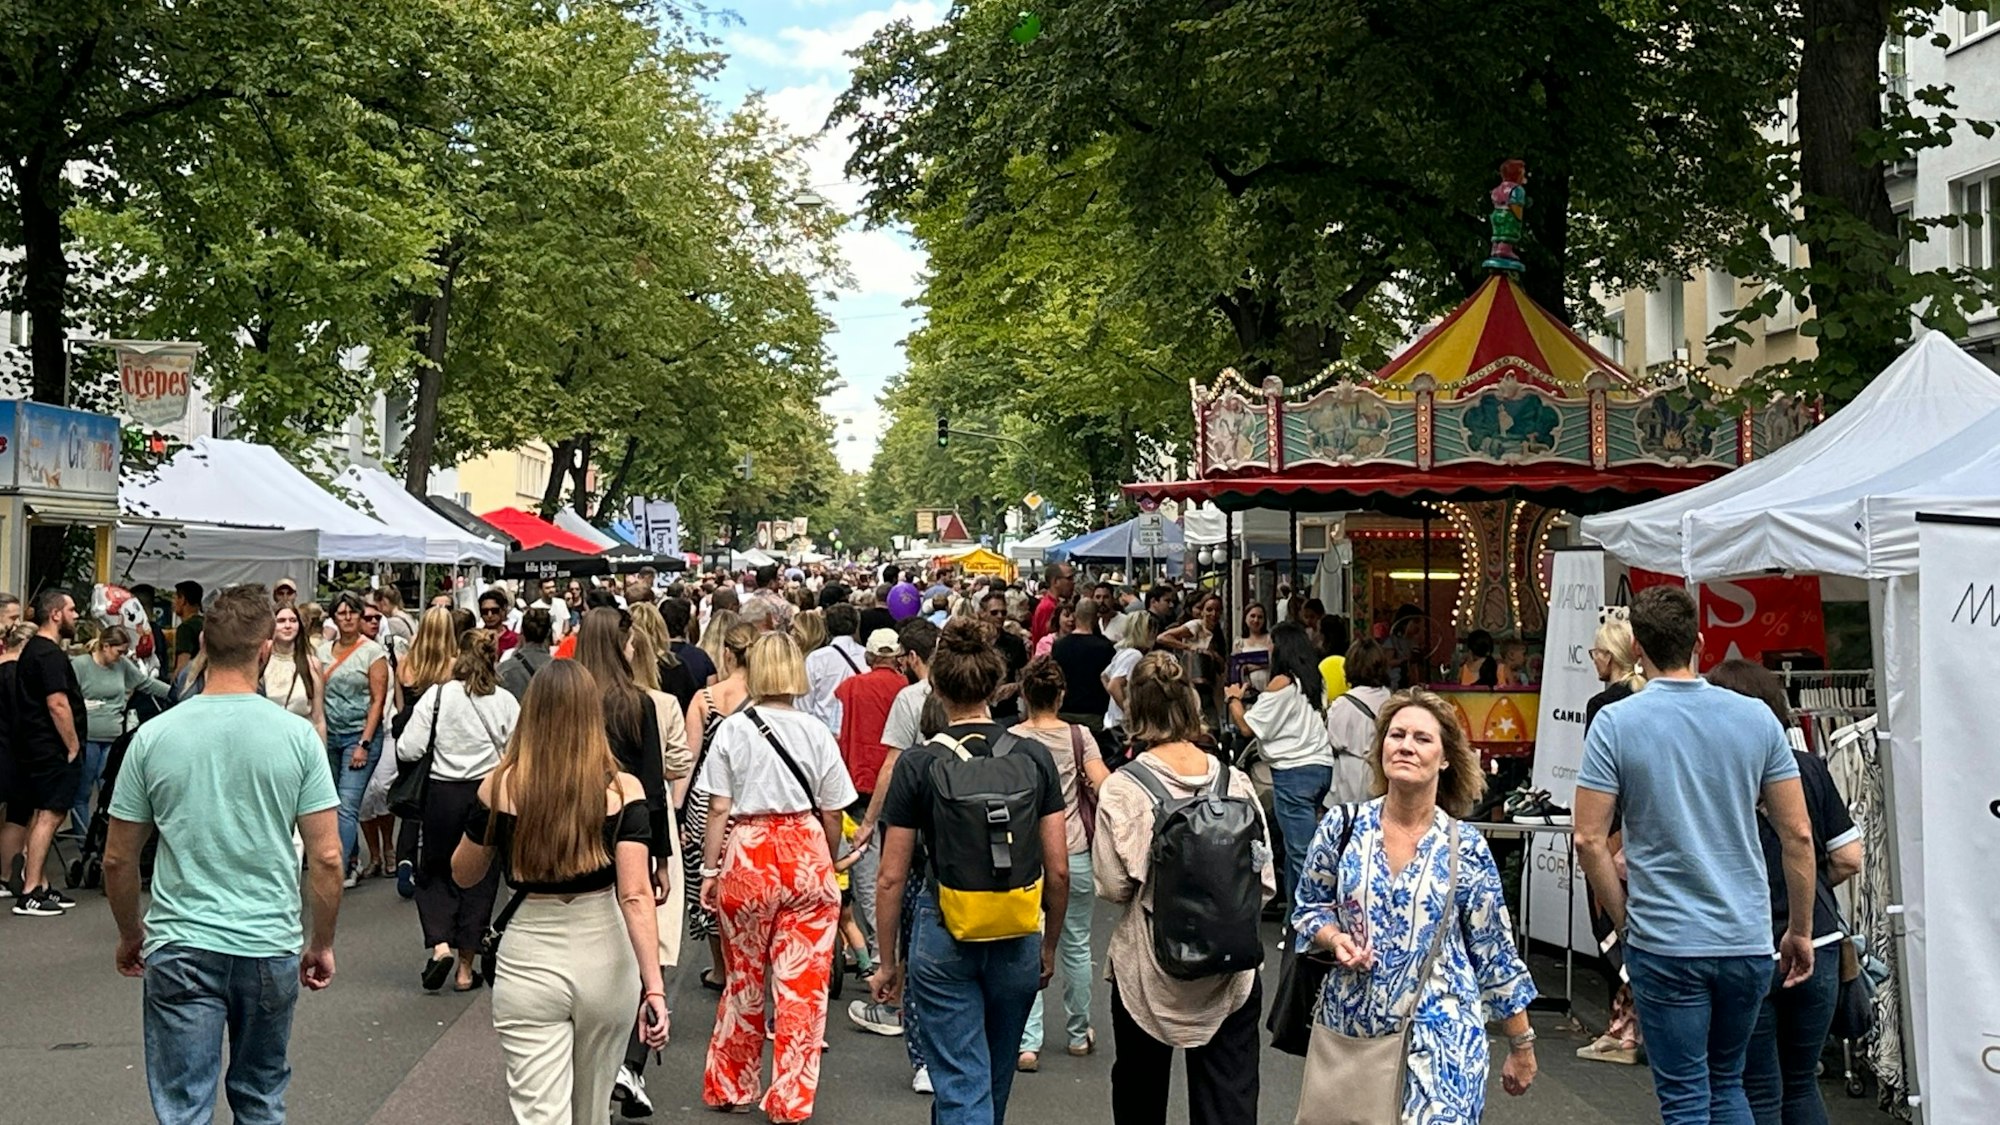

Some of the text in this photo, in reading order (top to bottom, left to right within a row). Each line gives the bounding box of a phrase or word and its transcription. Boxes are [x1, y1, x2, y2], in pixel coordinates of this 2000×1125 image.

[122, 365, 188, 400] Crêpes
[1568, 645, 1583, 664] NC
[1536, 853, 1582, 880] CORE
